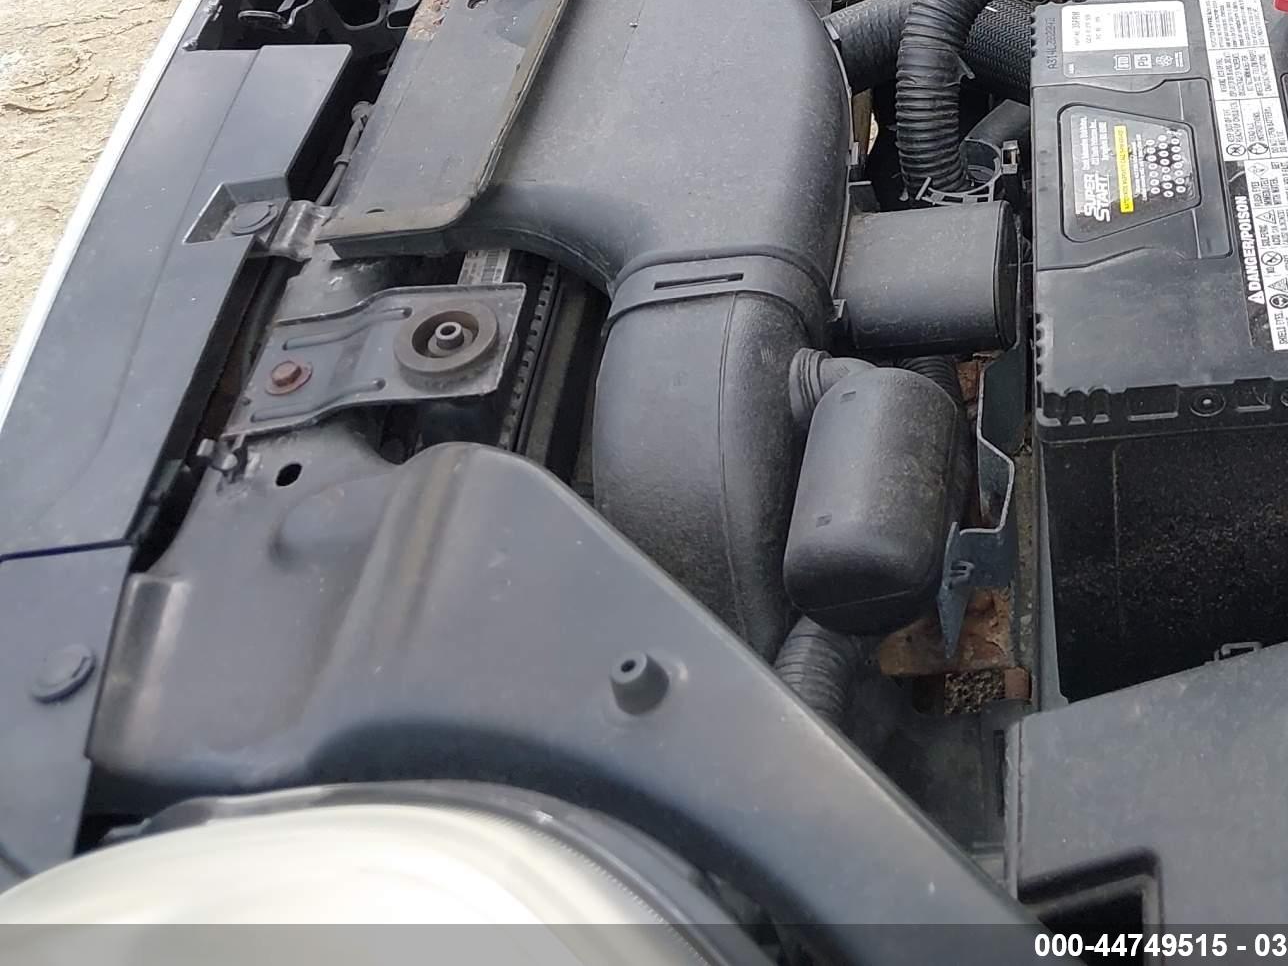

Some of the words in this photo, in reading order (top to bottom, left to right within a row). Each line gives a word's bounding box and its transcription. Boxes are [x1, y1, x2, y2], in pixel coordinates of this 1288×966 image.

[1138, 56, 1149, 67] Pb
[1084, 173, 1096, 217] SUPER
[1095, 172, 1110, 222] START
[1235, 195, 1261, 292] DANGER/POISON
[1276, 326, 1288, 345] SHIELD
